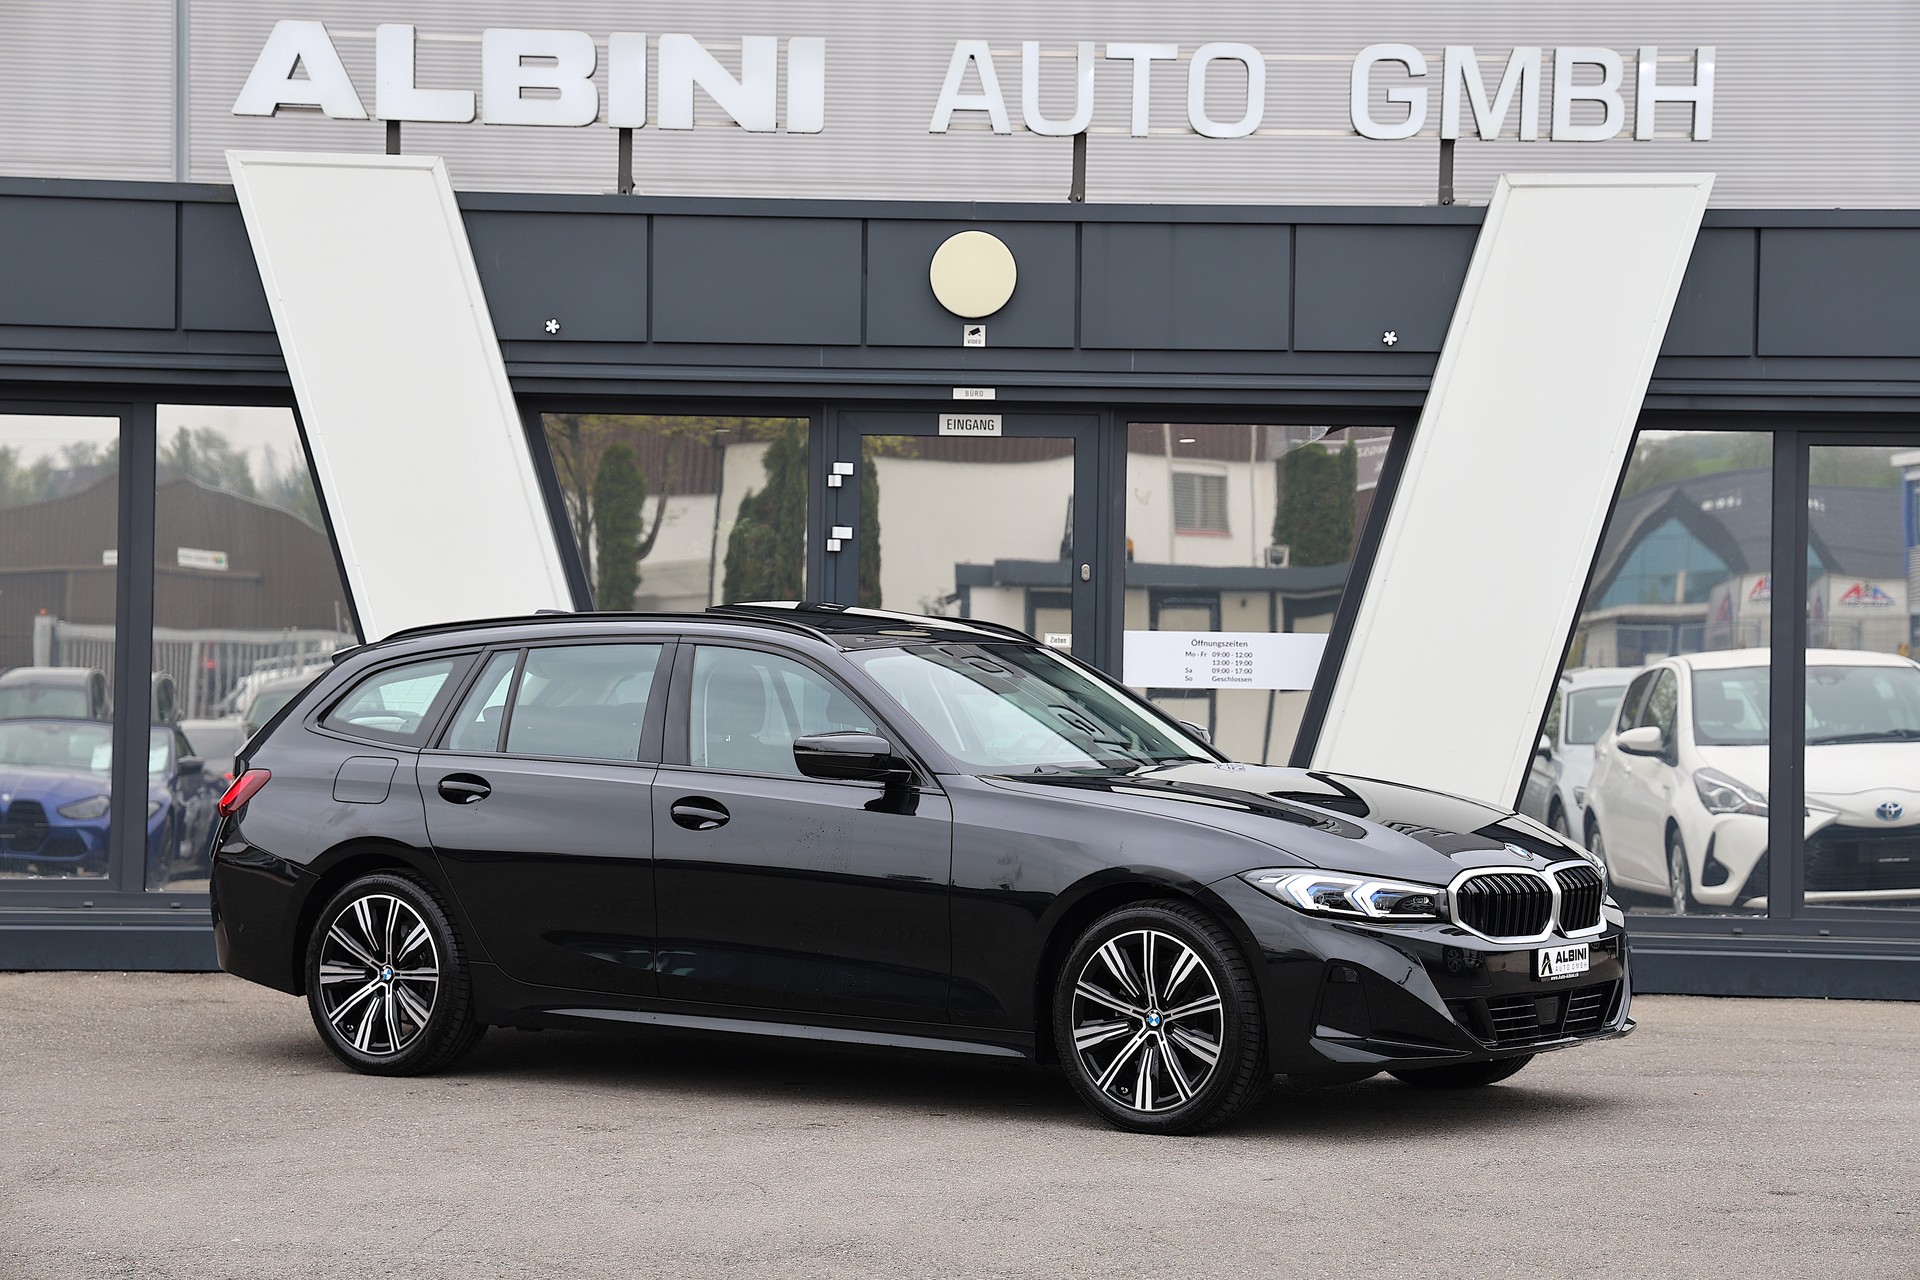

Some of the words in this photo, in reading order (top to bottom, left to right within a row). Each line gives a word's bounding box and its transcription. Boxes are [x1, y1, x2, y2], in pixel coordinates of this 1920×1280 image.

[231, 19, 826, 134] ALBINI
[928, 39, 1266, 139] AUTO
[1349, 43, 1717, 142] GMBH
[965, 389, 984, 397] BÜRO
[946, 419, 995, 431] EINGANG
[1191, 639, 1248, 648] Öffnungszeiten
[1556, 948, 1587, 964] ALBINI
[1555, 964, 1570, 972] AUTO
[1572, 962, 1587, 970] GMBH
